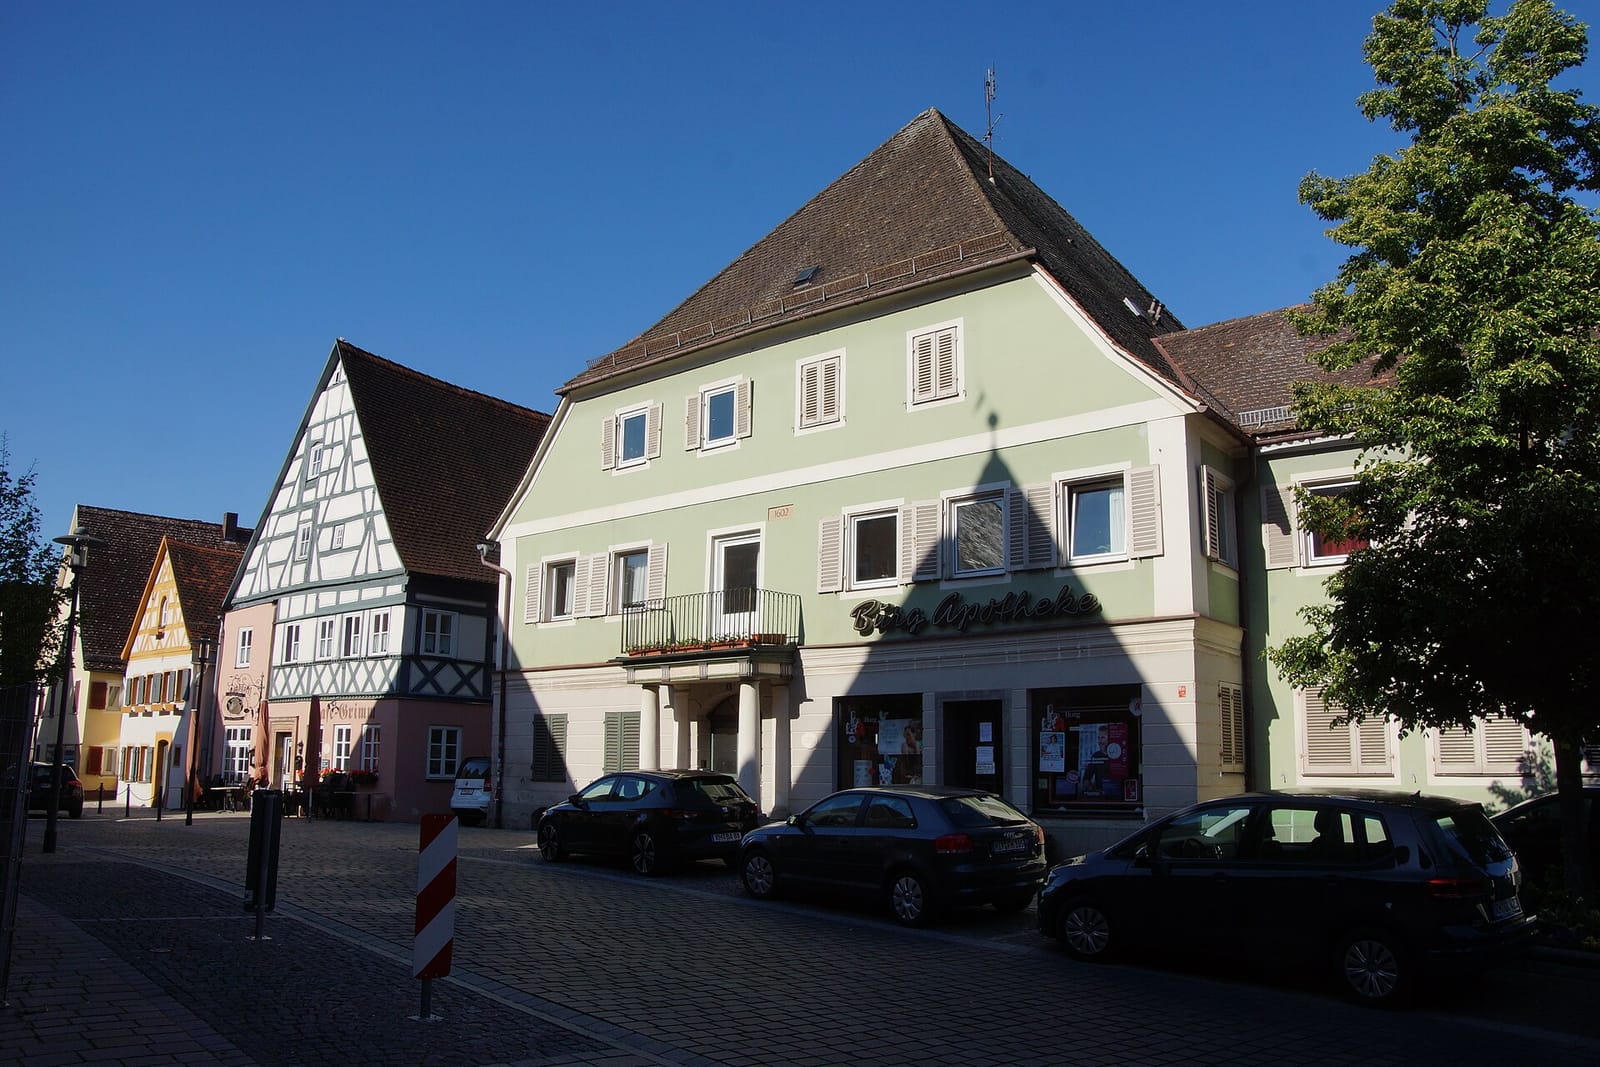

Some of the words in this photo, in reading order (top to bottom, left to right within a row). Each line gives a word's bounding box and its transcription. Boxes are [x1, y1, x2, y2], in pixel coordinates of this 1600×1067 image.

[853, 598, 925, 634] Burg
[932, 584, 1100, 632] Apotheke
[339, 702, 376, 720] Grimm
